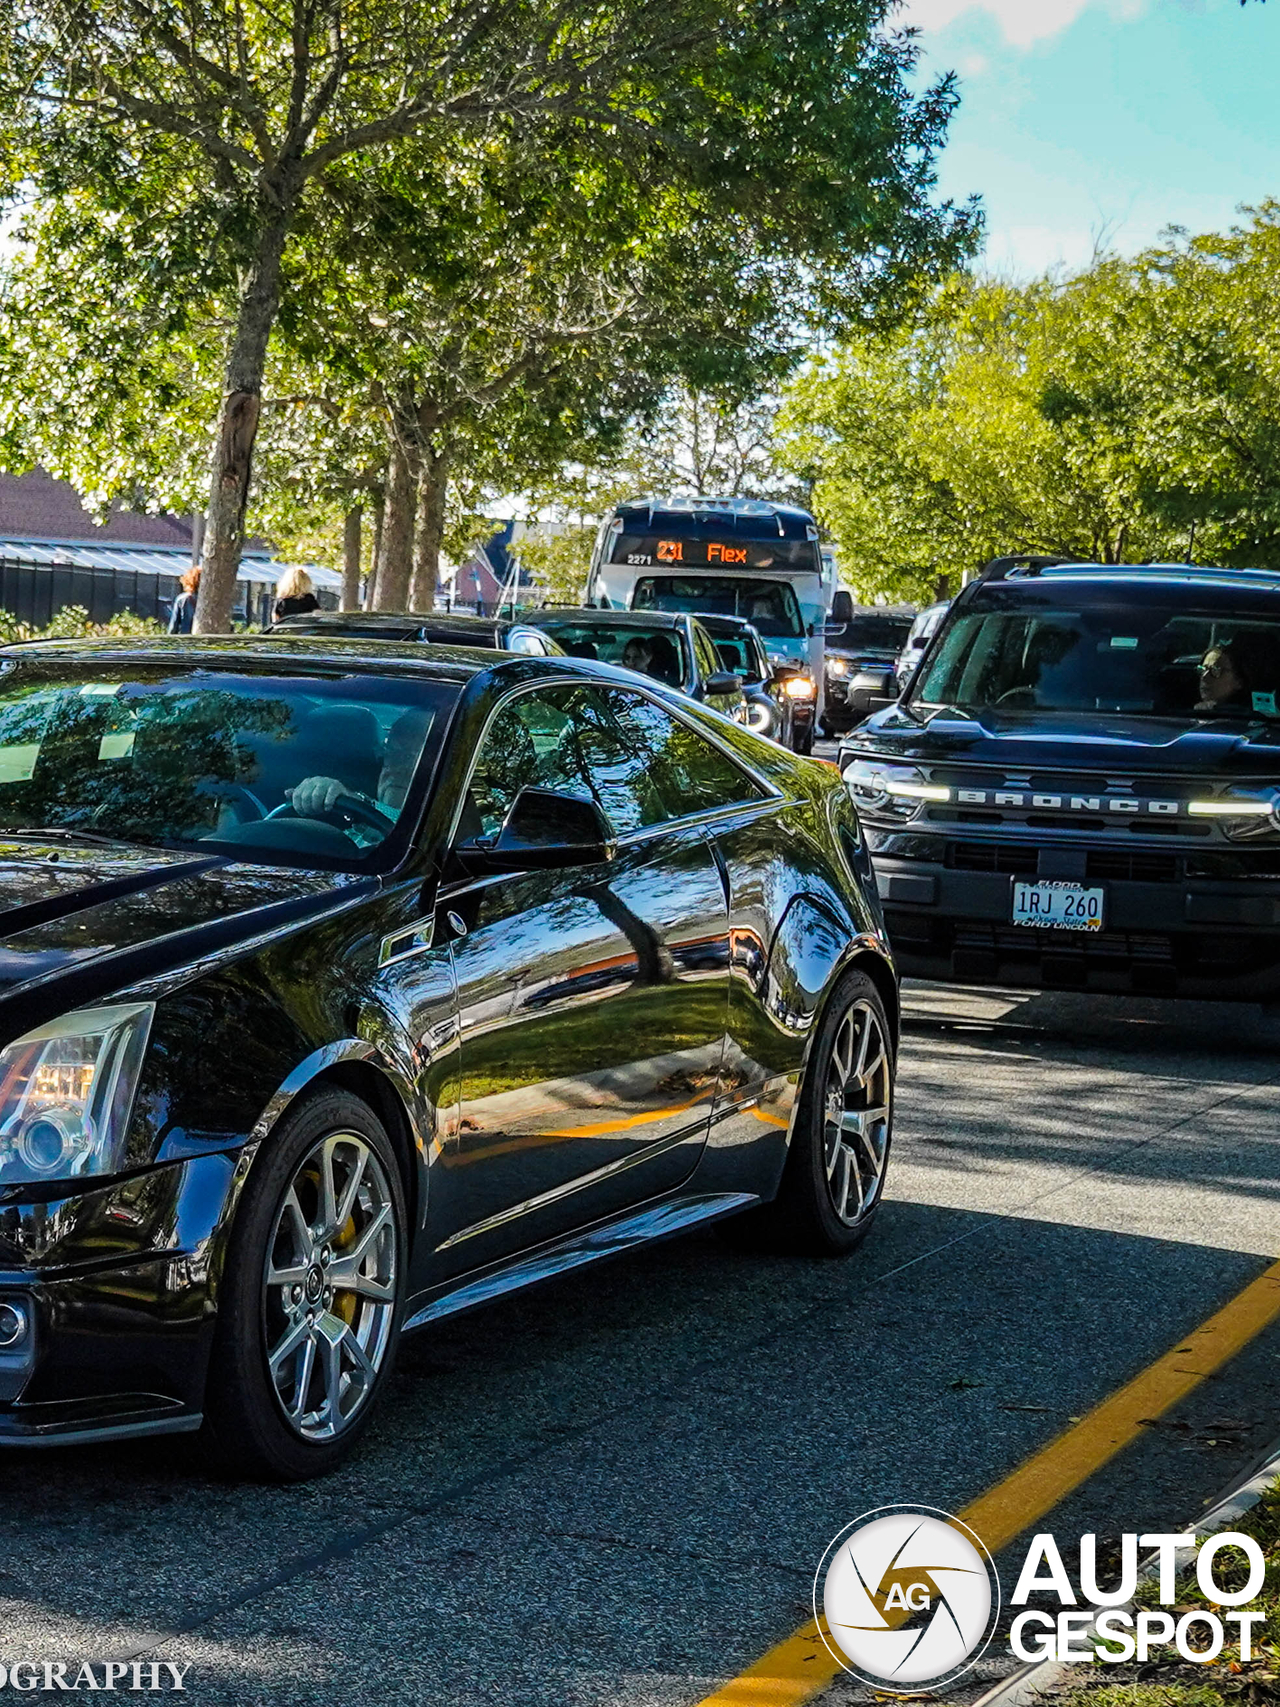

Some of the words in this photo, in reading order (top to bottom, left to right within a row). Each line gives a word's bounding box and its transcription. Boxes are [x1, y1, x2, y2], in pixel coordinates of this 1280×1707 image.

[627, 554, 652, 565] 2271
[656, 541, 683, 560] 231
[707, 543, 747, 564] Flex
[958, 790, 1178, 814] BRONCO
[1017, 891, 1052, 914] 1RJ
[1064, 895, 1098, 918] 260
[1013, 920, 1051, 928] FORD
[1053, 922, 1100, 932] LINCOLN
